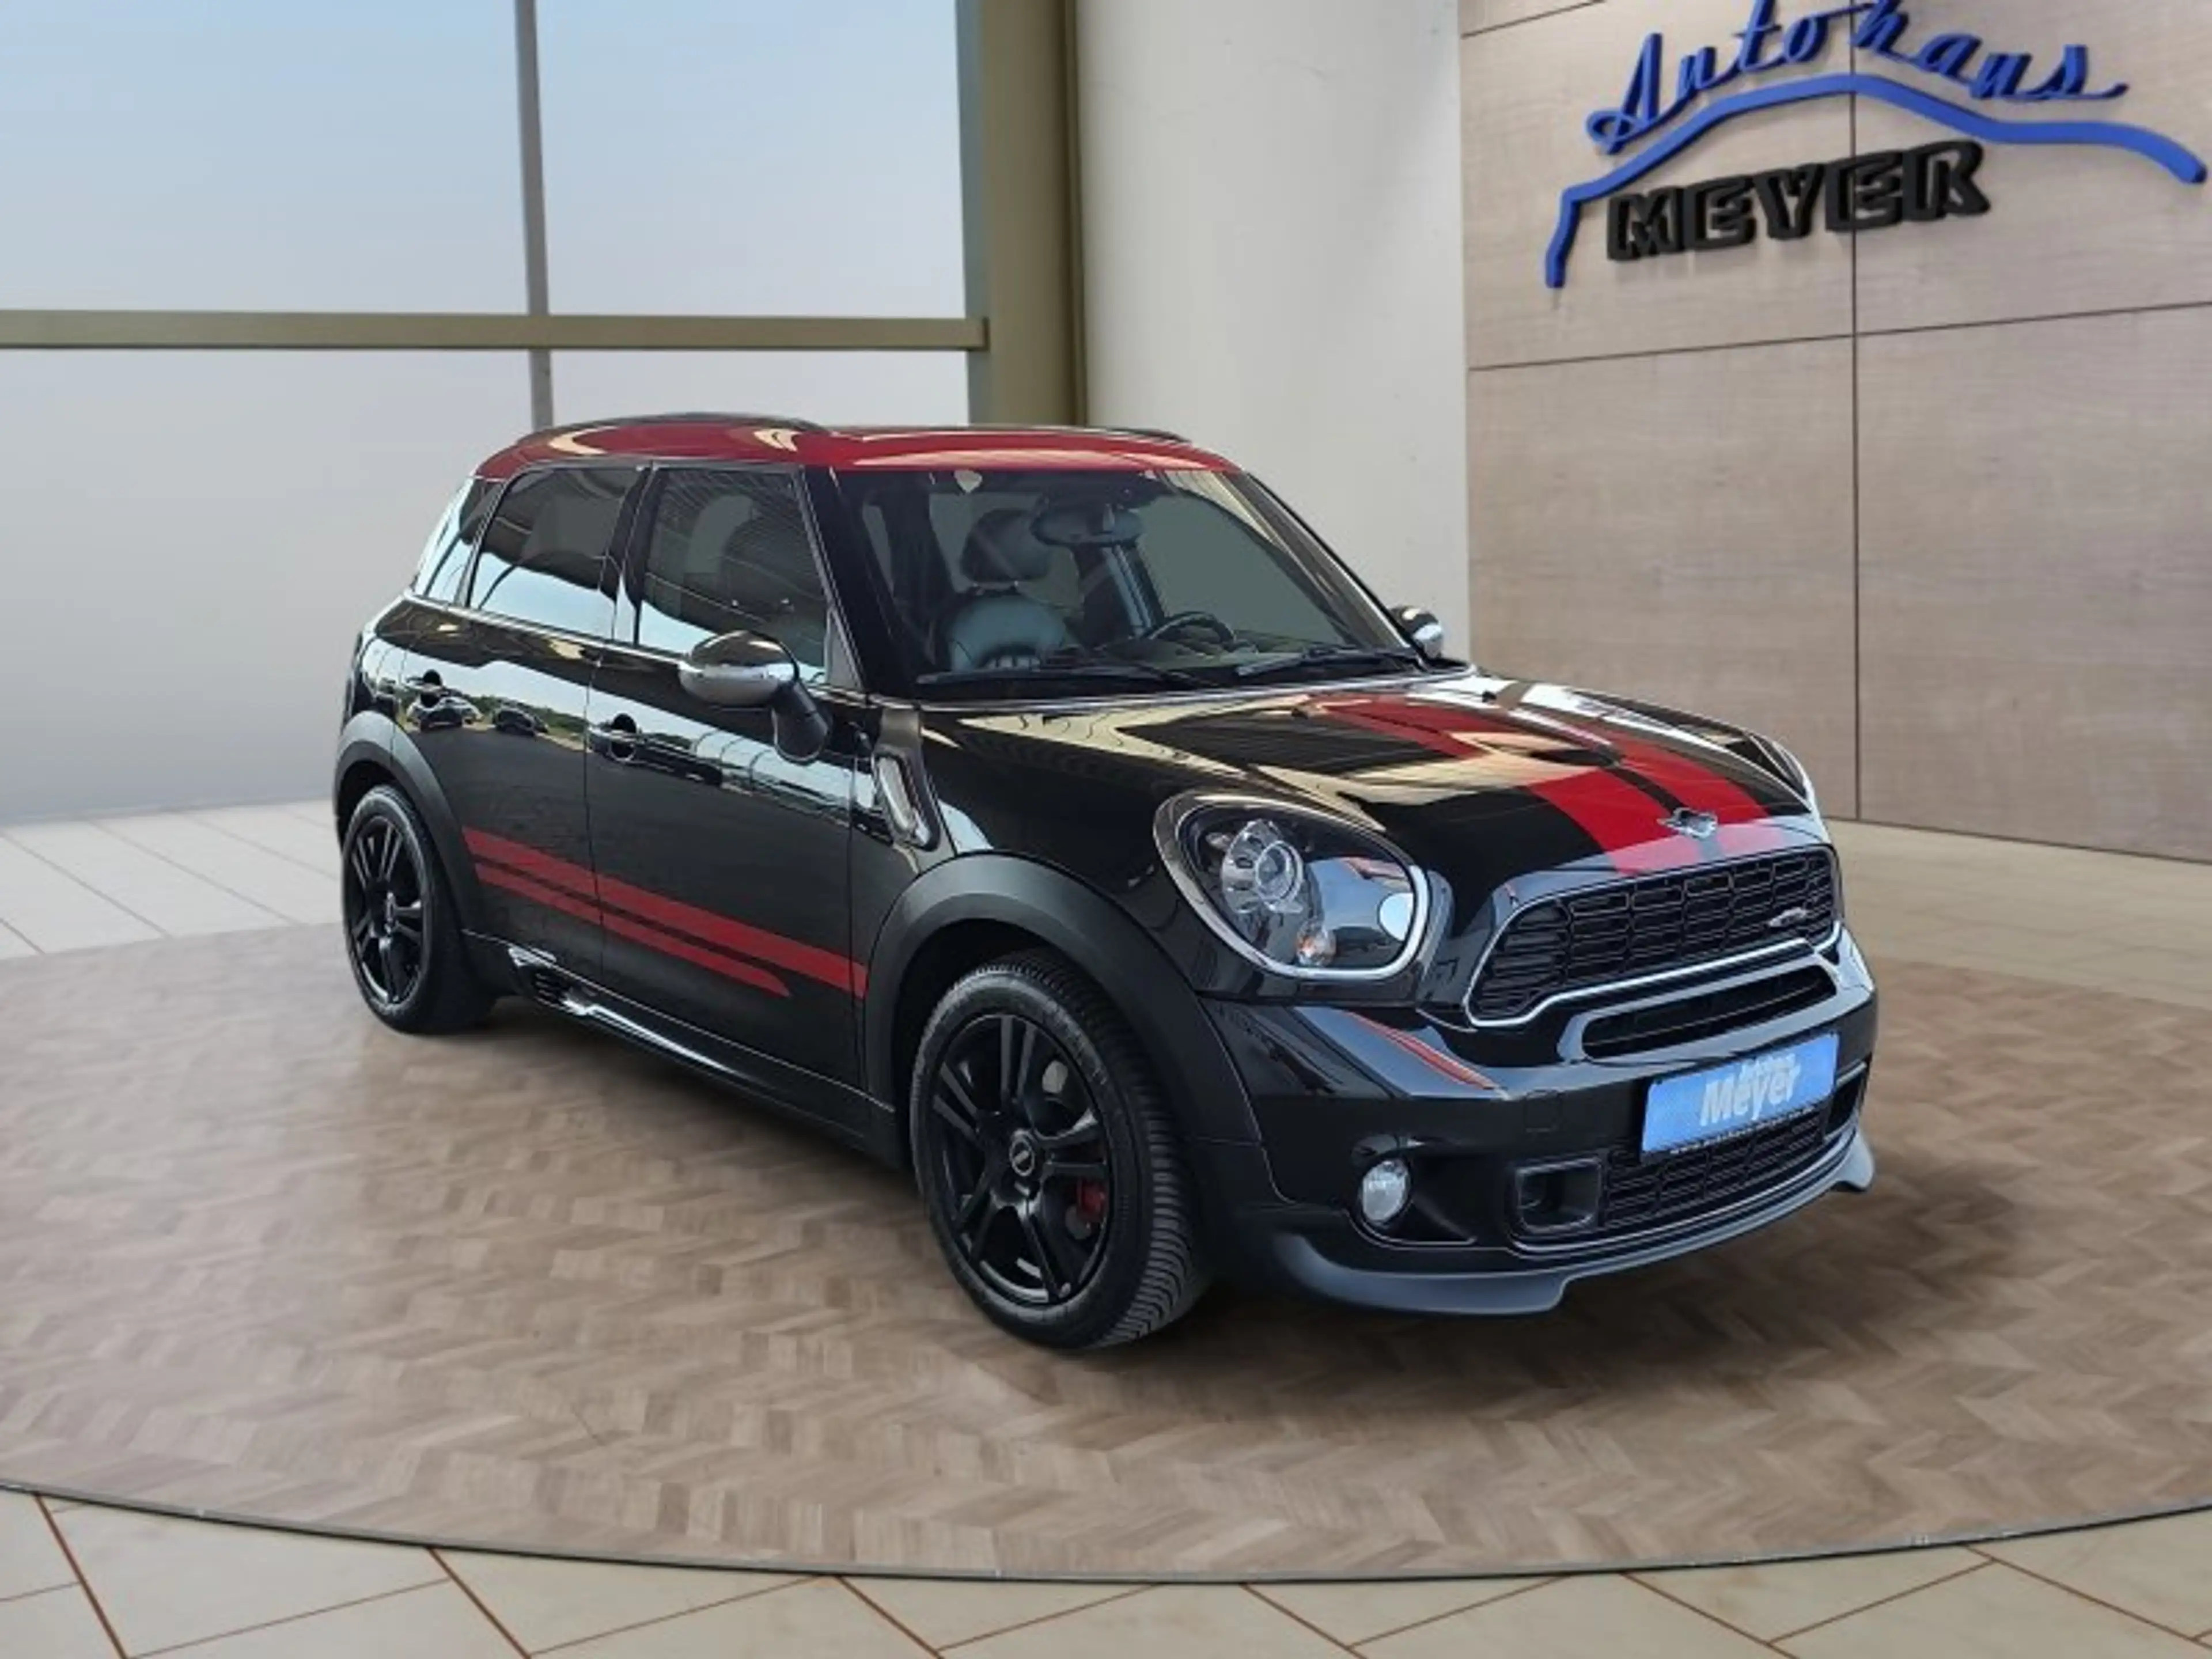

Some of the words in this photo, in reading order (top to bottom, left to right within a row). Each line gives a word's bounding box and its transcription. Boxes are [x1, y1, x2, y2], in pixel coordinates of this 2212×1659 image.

[1586, 0, 2128, 155] Autohaus
[1607, 140, 1991, 263] MEYER
[1700, 1062, 1801, 1127] Meyer
